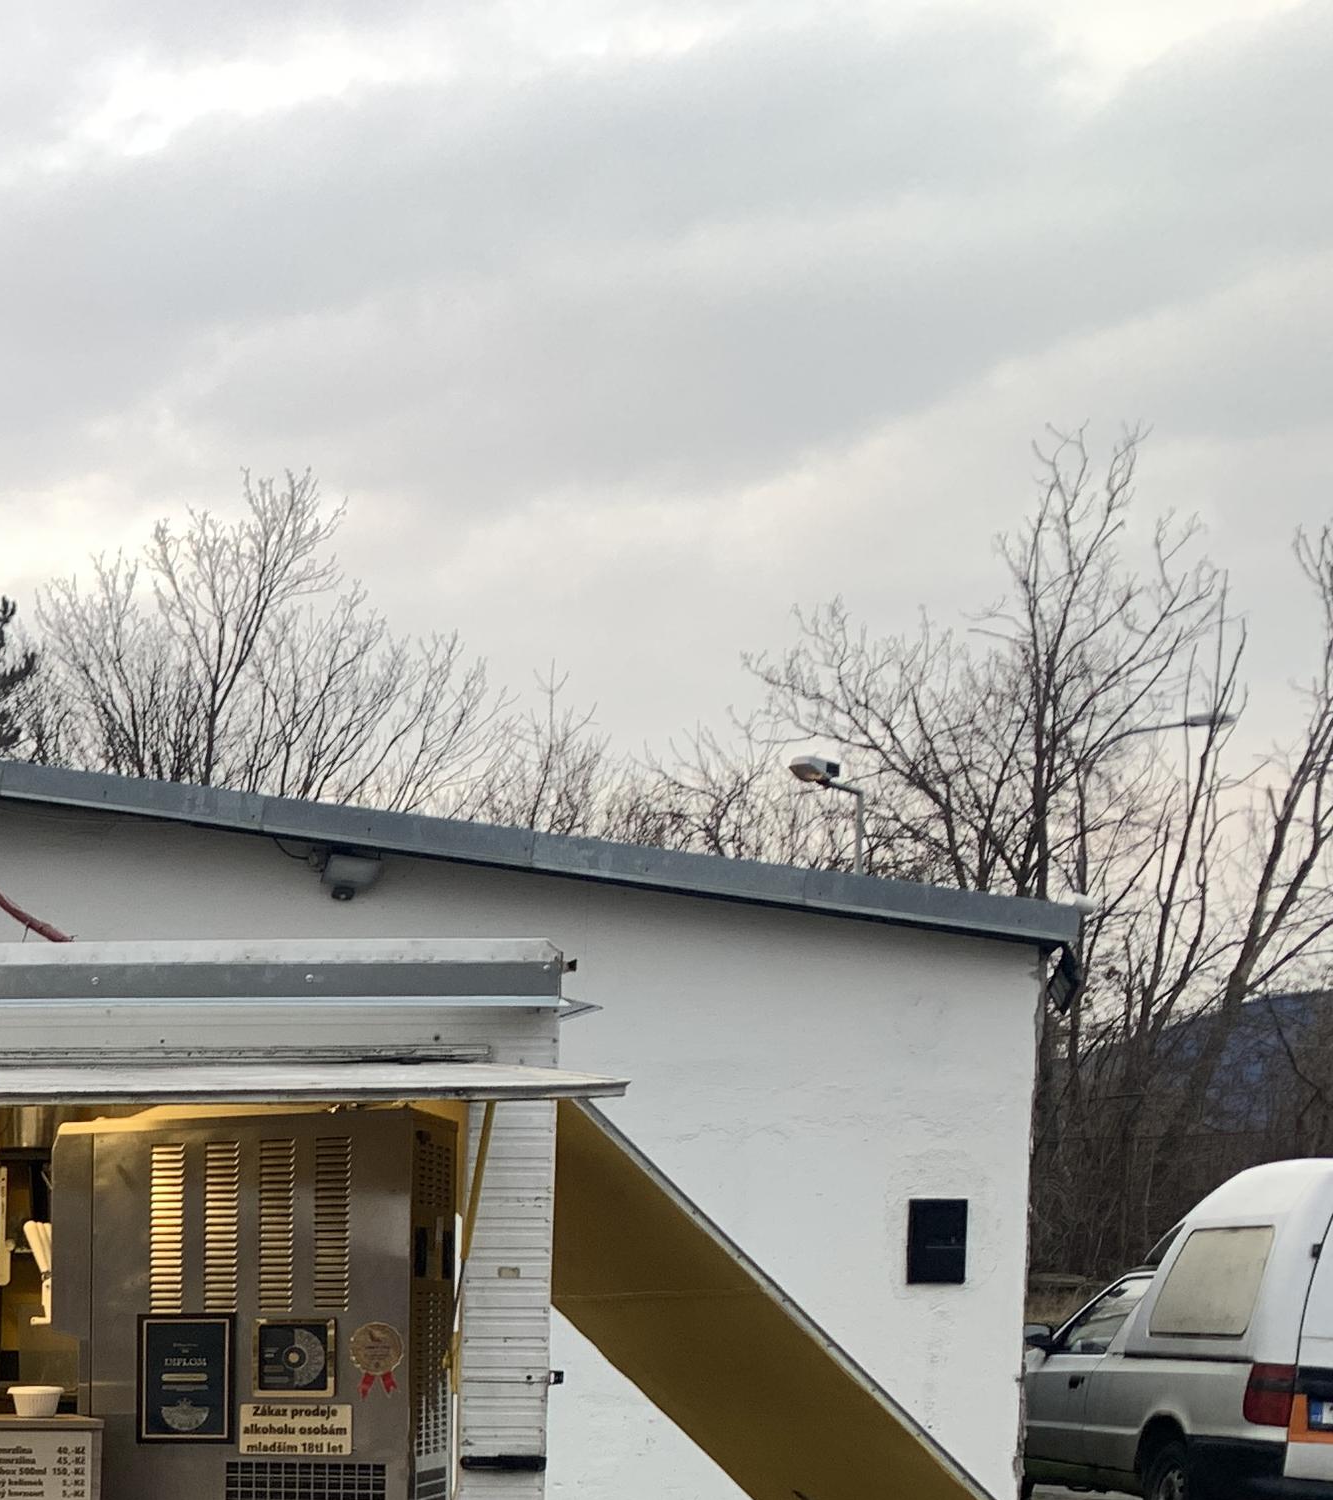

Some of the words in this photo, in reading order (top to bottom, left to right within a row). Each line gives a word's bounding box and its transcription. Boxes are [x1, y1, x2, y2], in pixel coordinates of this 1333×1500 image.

[252, 1404, 289, 1418] Zákaz
[291, 1406, 339, 1420] prodeje
[242, 1423, 296, 1437] alkoholu
[298, 1423, 348, 1437] osobám
[246, 1440, 298, 1454] mladším
[326, 1441, 344, 1454] let
[8, 1478, 43, 1487] kelímek
[8, 1488, 44, 1497] kornout
